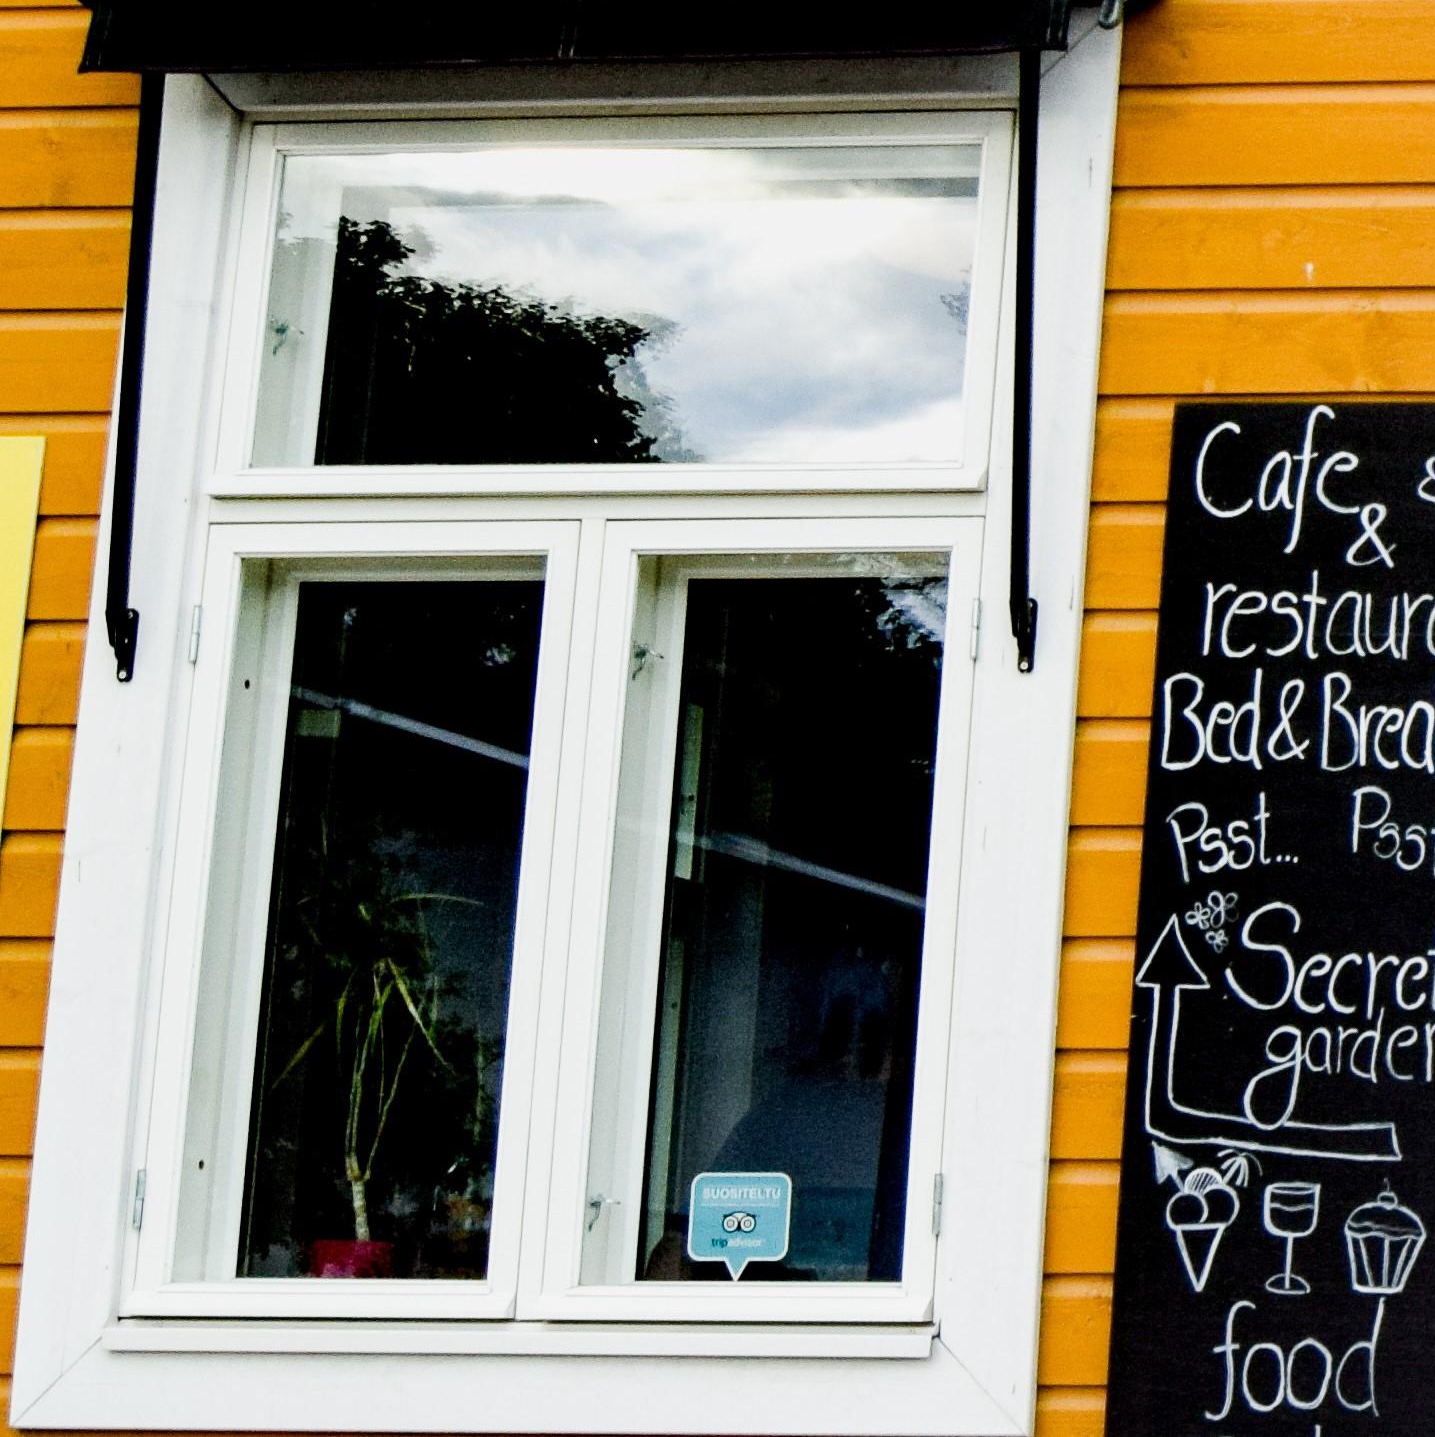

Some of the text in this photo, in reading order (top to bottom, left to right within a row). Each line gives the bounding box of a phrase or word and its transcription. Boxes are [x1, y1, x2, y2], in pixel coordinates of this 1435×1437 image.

[1195, 405, 1361, 554] Cafe
[1345, 503, 1396, 567] &
[1204, 1296, 1386, 1422] food
